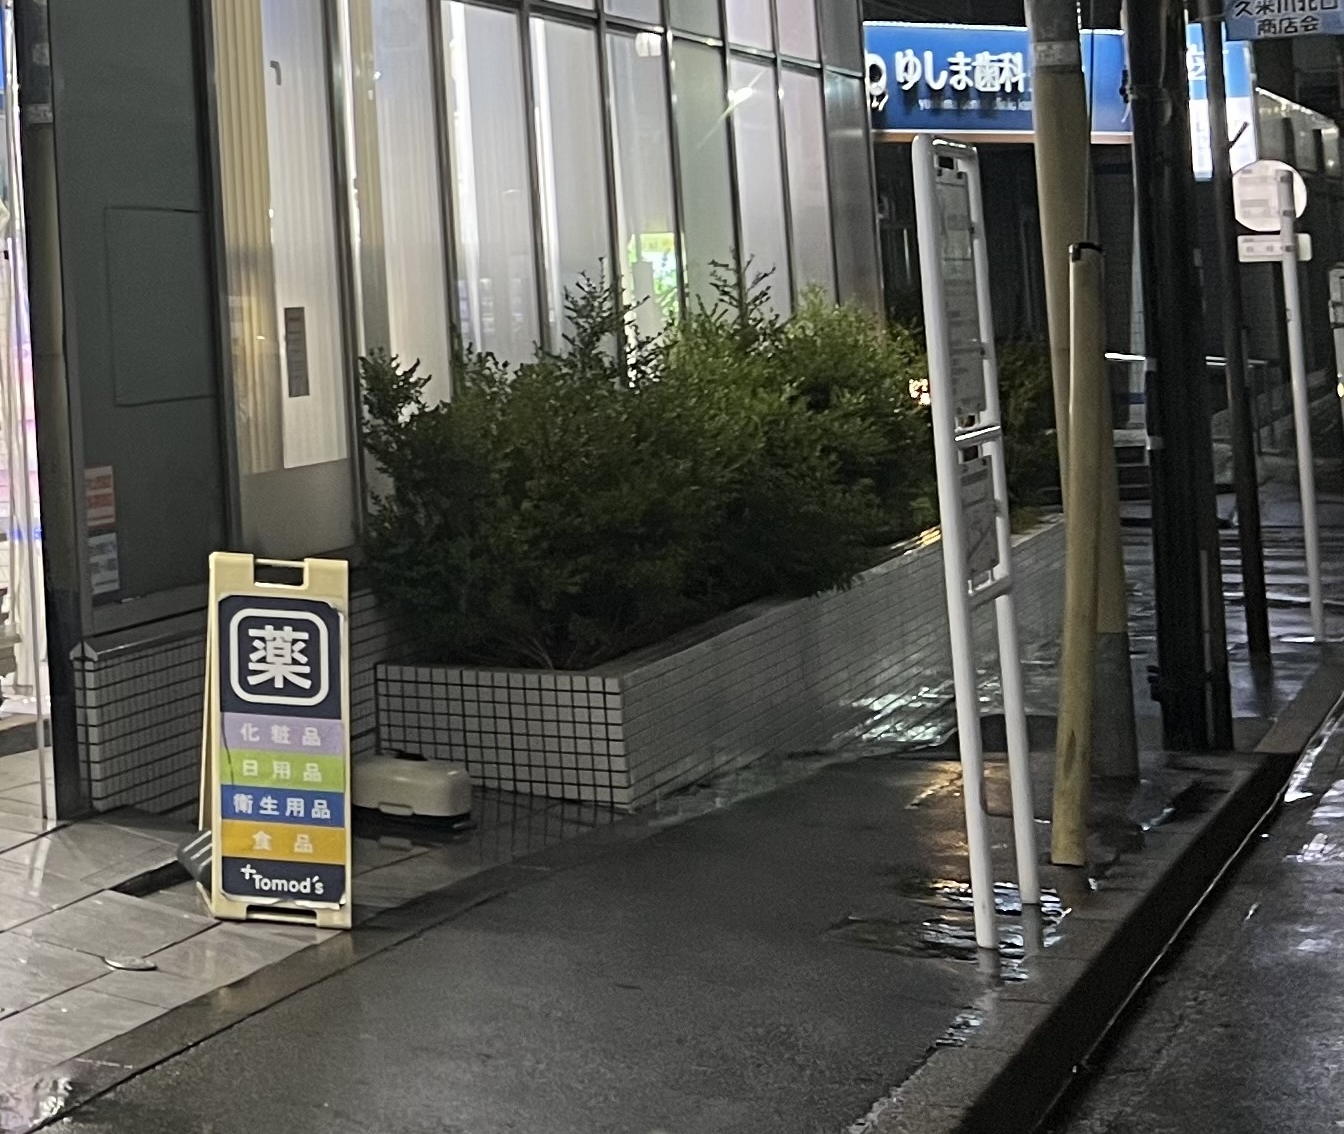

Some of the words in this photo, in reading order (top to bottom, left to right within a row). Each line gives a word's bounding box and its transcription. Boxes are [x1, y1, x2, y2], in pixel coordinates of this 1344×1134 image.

[1257, 16, 1320, 36] 商店会
[894, 49, 1027, 94] ゆしま歯科
[246, 624, 311, 690] 薬
[240, 721, 322, 747] 化粧品
[242, 759, 322, 783] 日用品
[233, 793, 331, 820] 衛生用品
[251, 830, 313, 854] 食品
[252, 873, 324, 896] Tomod's
